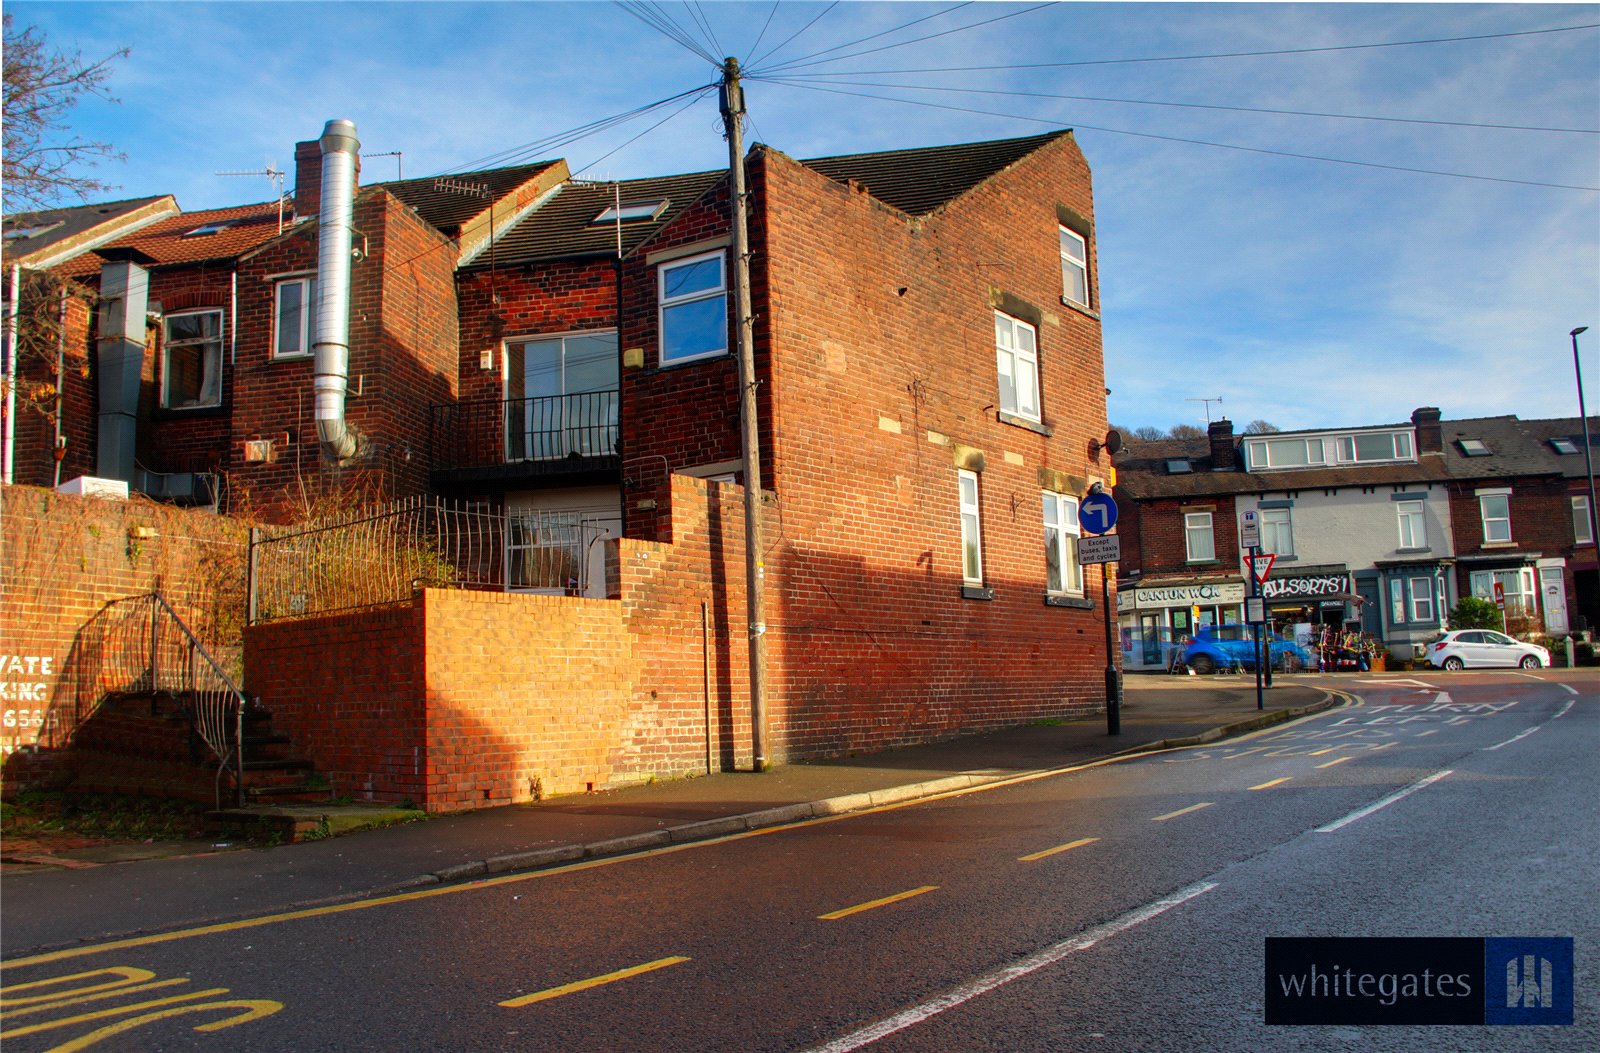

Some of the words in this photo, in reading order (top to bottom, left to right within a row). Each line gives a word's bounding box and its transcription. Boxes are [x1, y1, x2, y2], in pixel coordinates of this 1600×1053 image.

[1088, 538, 1109, 546] Except
[1138, 590, 1186, 603] CANTON
[1189, 585, 1220, 600] WOK
[1263, 577, 1348, 598] ALLSORTS!
[1367, 702, 1519, 714] TURN
[1328, 715, 1480, 726] LEFT
[1257, 728, 1393, 743] BUS
[1164, 743, 1379, 763] STOP
